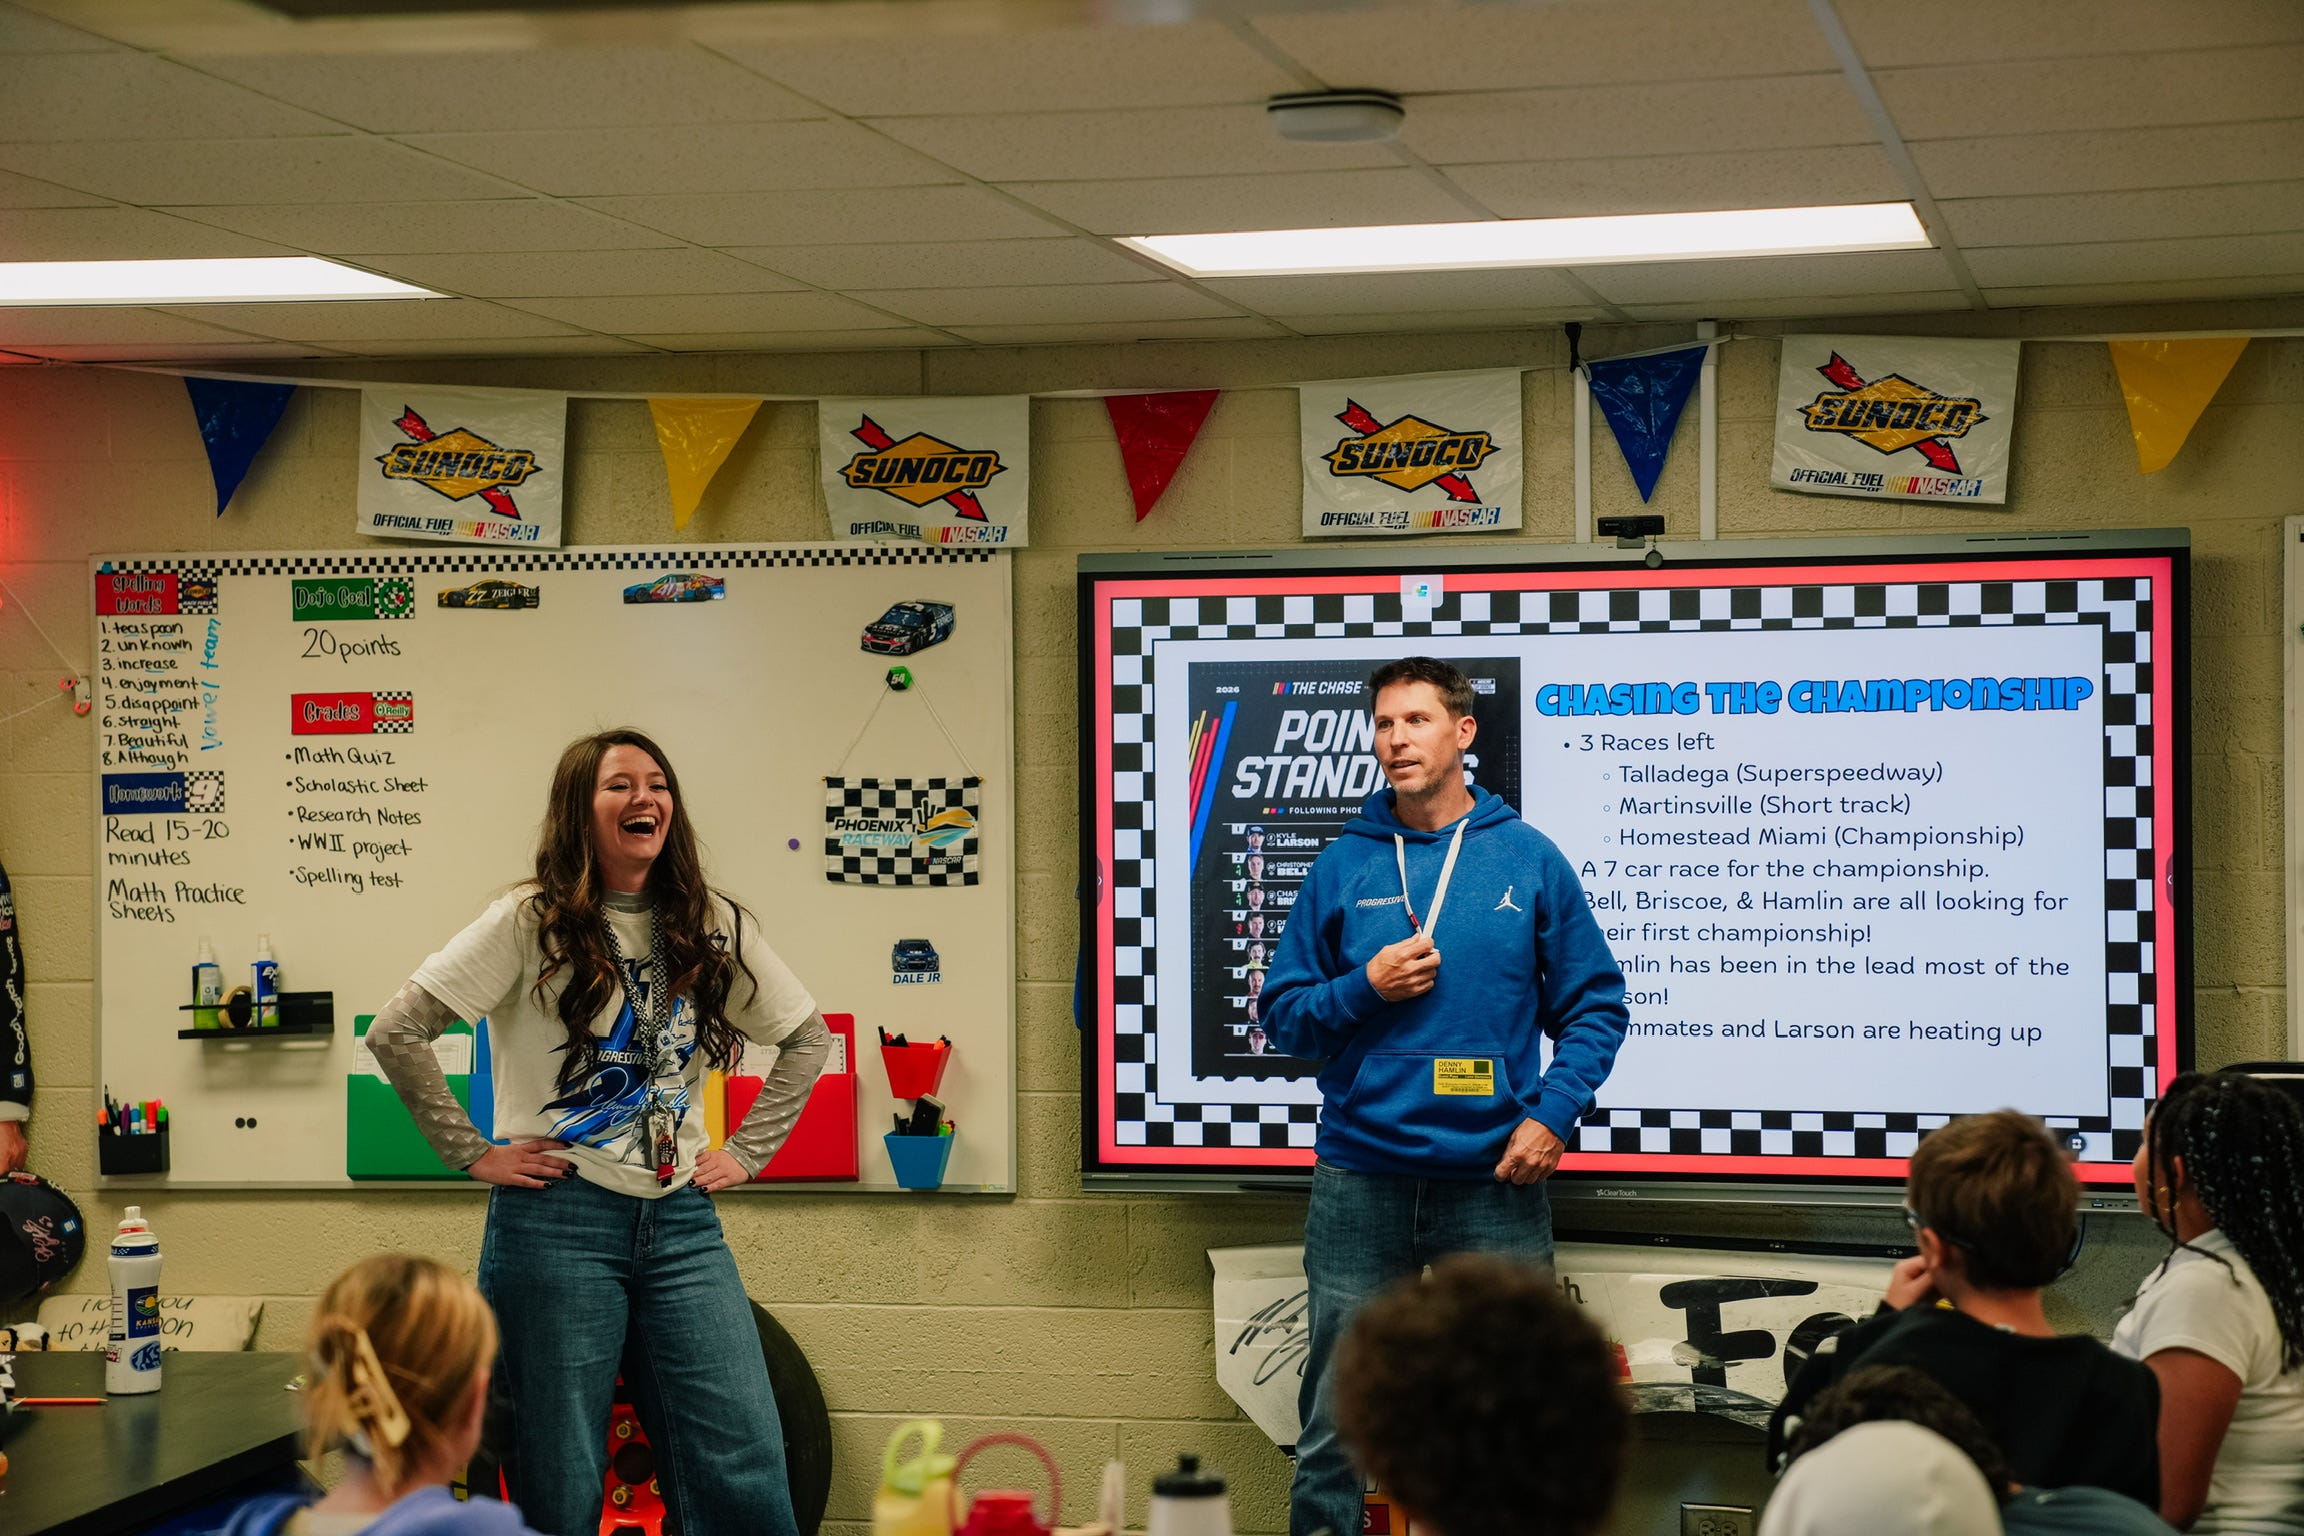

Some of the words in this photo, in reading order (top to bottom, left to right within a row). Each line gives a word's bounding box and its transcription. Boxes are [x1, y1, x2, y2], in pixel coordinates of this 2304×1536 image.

[1813, 399, 1973, 431] SUNOCO
[1337, 438, 1484, 469] SUNOCO
[390, 449, 526, 480] SUNOCO
[853, 457, 992, 484] SUNOCO
[1790, 468, 1848, 485] OFFICIAL
[1853, 473, 1884, 486] FUEL
[1917, 478, 1982, 496] NASCAR
[373, 513, 422, 529] OFFICIAL
[426, 518, 453, 530] FUEL
[1320, 511, 1375, 526] OFFICIAL
[1379, 511, 1409, 524] FUEL
[1441, 507, 1501, 526] NASCAR
[483, 523, 540, 540] NASCAR
[850, 520, 895, 535] OFFICIAL
[899, 524, 922, 536] FUEL
[950, 526, 1007, 542] NASCAR
[116, 595, 162, 613] Words
[295, 586, 335, 609] Dojo
[337, 586, 371, 608] Goal
[113, 622, 183, 639] teaspoon
[101, 639, 115, 653] 2.
[200, 617, 221, 669] team
[302, 628, 336, 658] 20
[340, 634, 401, 664] points
[102, 658, 115, 671] 3.
[118, 657, 178, 670] increase
[102, 677, 117, 689] 4.
[119, 677, 198, 692] enjoyment
[1292, 682, 1317, 695] THE
[1319, 681, 1363, 695] CHASE
[121, 695, 199, 714] disappoint
[304, 700, 359, 723] Grades
[118, 732, 188, 748] Beautiful
[1274, 710, 1376, 753] POIN
[1579, 734, 1594, 751] 3
[1601, 734, 1668, 751] Races
[1677, 732, 1715, 751] left
[118, 750, 188, 770] Although
[295, 747, 344, 764] Math
[347, 747, 395, 765] Quiz
[1619, 764, 1729, 788] Talladega
[1737, 761, 1943, 787] (Superspeedway)
[109, 782, 182, 803] Homework
[295, 776, 379, 793] Scholastic
[384, 777, 428, 792] Sheet
[1289, 806, 1337, 815] FOLLOWING
[1340, 806, 1362, 815] PHOE
[1620, 796, 1752, 814] Martinsville
[1760, 795, 1832, 815] (Short
[1840, 793, 1911, 815] track)
[297, 806, 371, 824] Research
[377, 808, 421, 825] Notes
[106, 816, 155, 844] Read
[167, 819, 230, 841] 15-20
[835, 819, 906, 832] PHOENIX
[841, 833, 913, 846] RACEWAY
[1276, 839, 1319, 847] LARSON
[1620, 827, 1750, 845] Homestead
[1759, 826, 1825, 845] Miami
[1835, 825, 2024, 851] (Championship)
[108, 849, 190, 866] minutes
[353, 839, 412, 863] project
[933, 856, 962, 865] NASCAR
[295, 866, 363, 893] Spelling
[369, 871, 403, 887] test
[1581, 861, 1597, 877] A
[1605, 861, 1617, 877] 7
[1625, 865, 1662, 877] car
[1669, 865, 1720, 877] race
[1728, 859, 1760, 877] for
[1766, 859, 1804, 877] the
[1813, 859, 1990, 882] championship.
[108, 878, 166, 903] Math
[175, 881, 246, 904] Practice
[109, 901, 175, 923] Sheets
[1584, 890, 1627, 912] Bell,
[1636, 890, 1728, 912] Briscoe,
[1737, 891, 1753, 909] &
[1763, 890, 1843, 910] Hamlin
[1852, 896, 1890, 910] are
[1900, 890, 1926, 910] all
[1936, 890, 2024, 916] looking
[2034, 891, 2069, 910] for
[1602, 922, 1636, 941] eir
[1642, 922, 1690, 941] first
[1697, 923, 1871, 948] championship!
[1617, 954, 1660, 973] mlin
[1670, 954, 1711, 973] has
[1720, 955, 1777, 974] been
[1787, 955, 1807, 974] in
[1816, 956, 1856, 974] the
[1865, 956, 1915, 975] lead
[1925, 958, 1986, 975] most
[1995, 957, 2020, 975] of
[2028, 957, 2070, 976] the
[893, 973, 924, 984] DALE
[927, 973, 941, 982] JR
[1623, 987, 1668, 1005] son!
[1629, 1020, 1713, 1037] mmates
[1721, 1019, 1765, 1038] and
[1775, 1019, 1855, 1039] Larson
[1863, 1024, 1901, 1040] are
[1909, 1020, 2001, 1047] heating
[2010, 1026, 2043, 1047] up
[597, 1050, 644, 1064] GRESSIV
